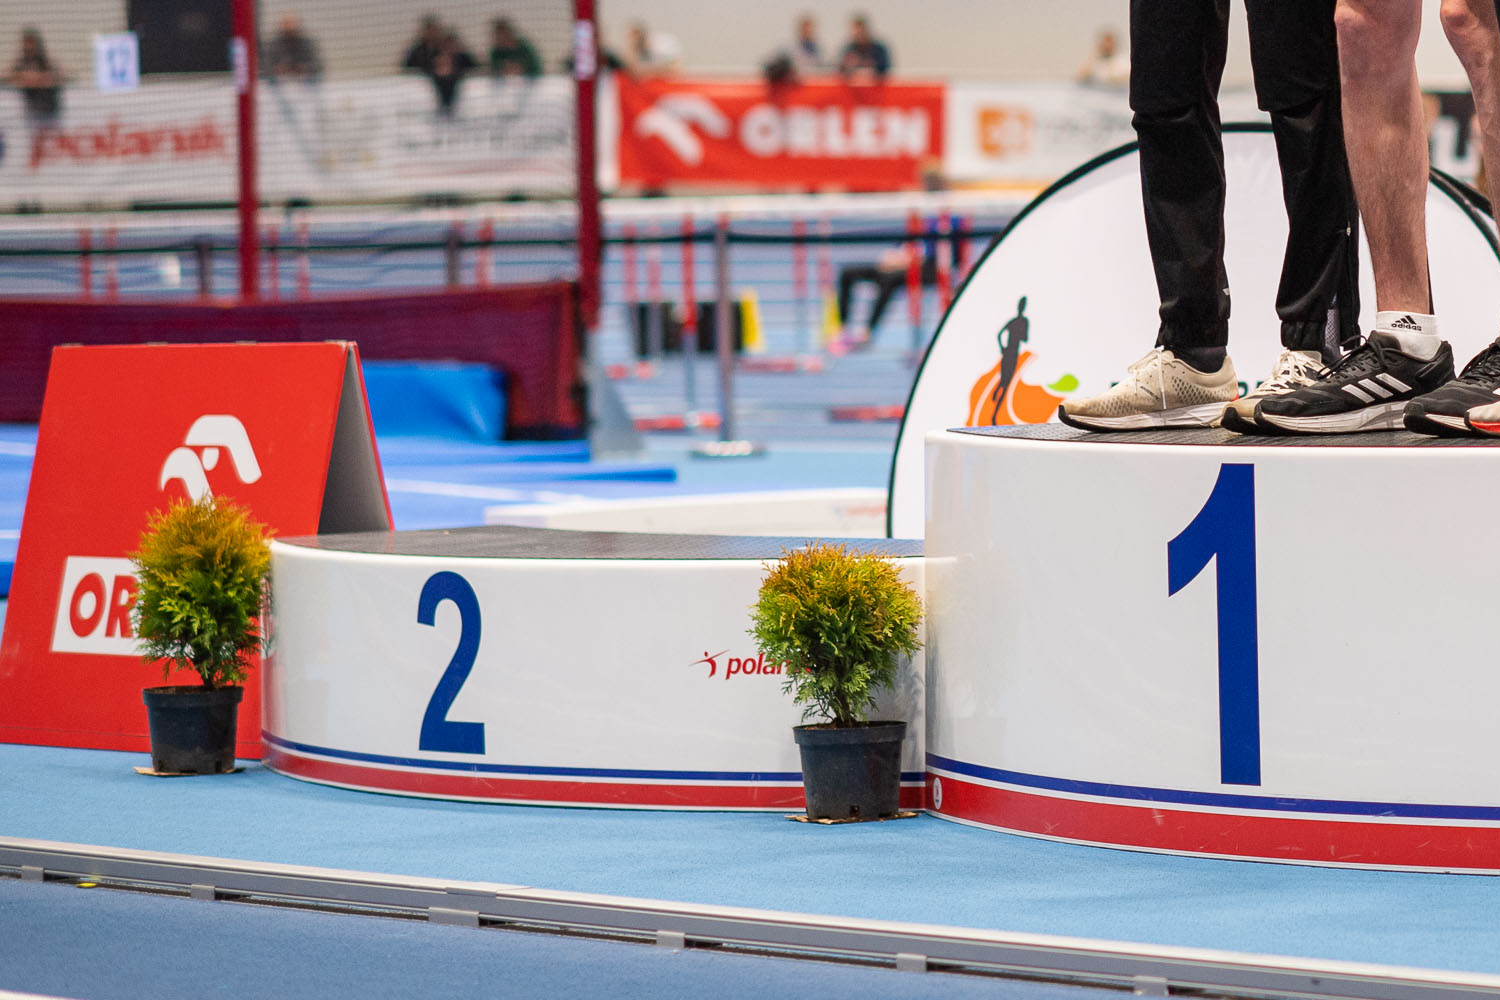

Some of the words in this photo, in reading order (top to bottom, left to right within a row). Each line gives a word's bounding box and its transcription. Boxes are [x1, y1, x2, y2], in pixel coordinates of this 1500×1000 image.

[739, 103, 930, 158] ORLEN
[1391, 322, 1422, 331] adidas
[1167, 463, 1262, 786] 1
[416, 570, 486, 755] 2
[725, 651, 800, 681] polan
